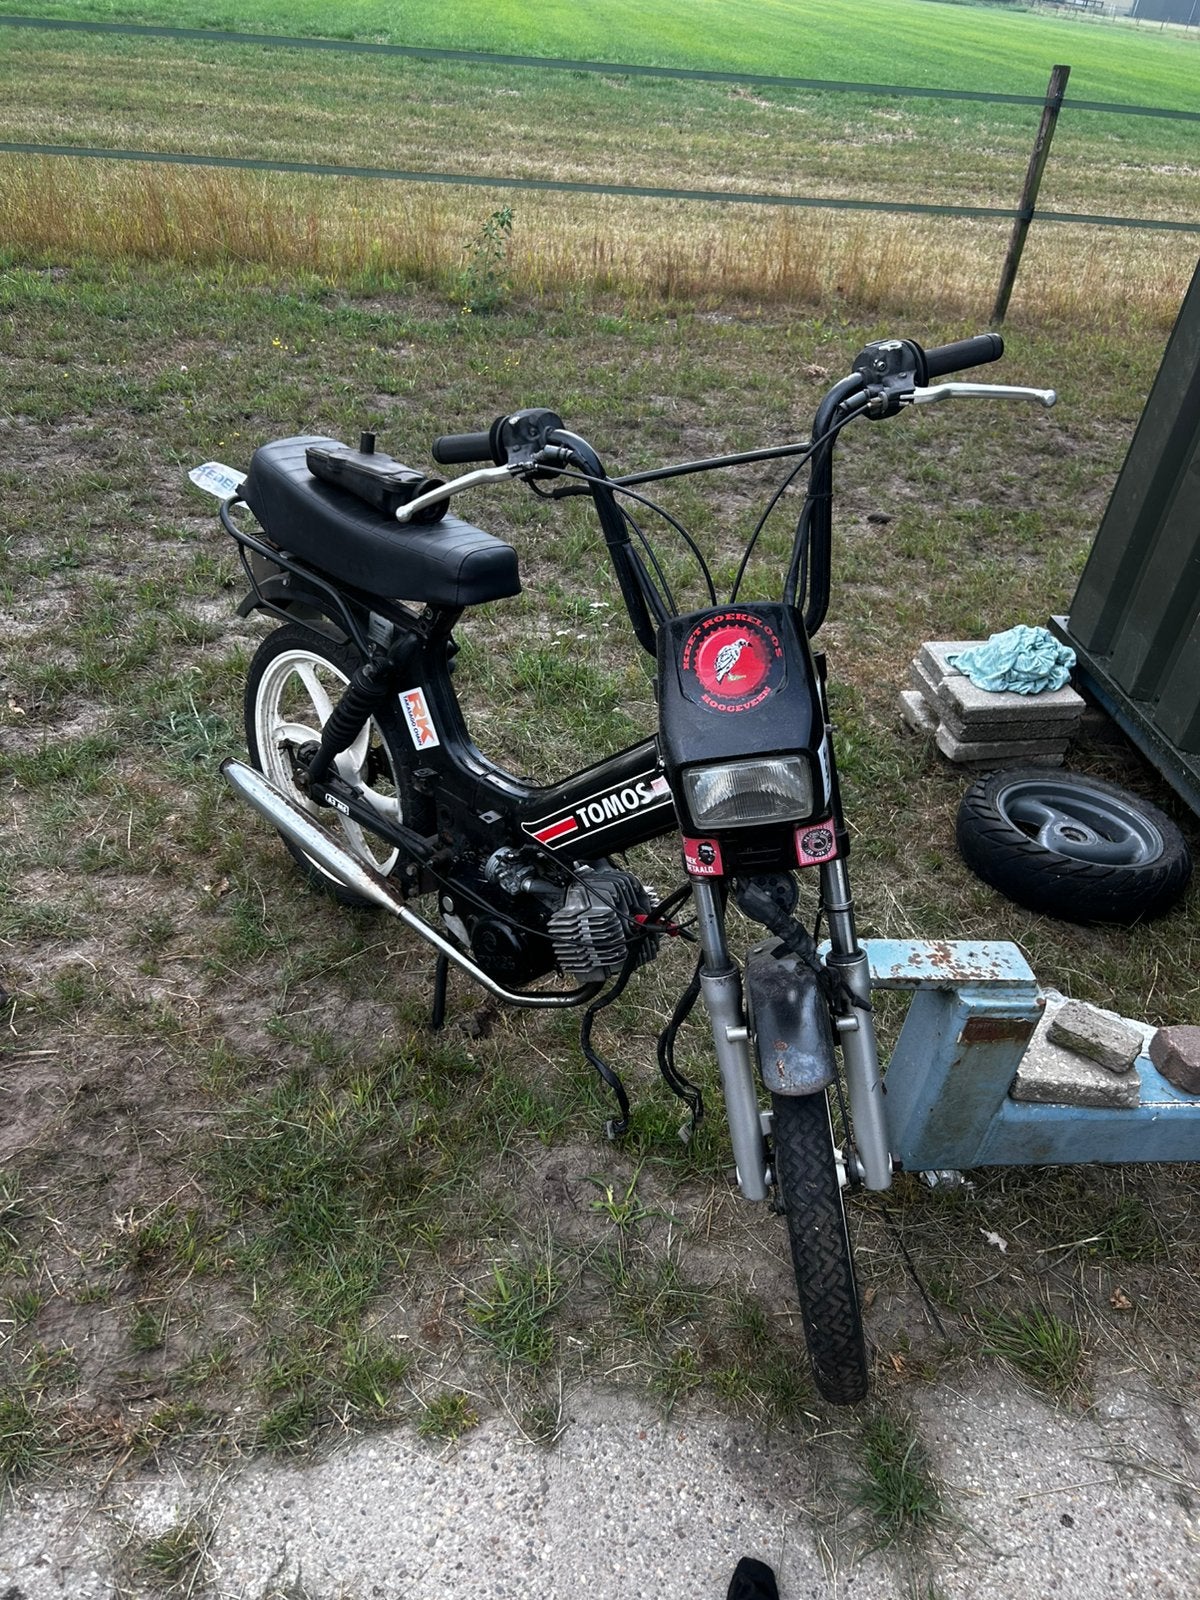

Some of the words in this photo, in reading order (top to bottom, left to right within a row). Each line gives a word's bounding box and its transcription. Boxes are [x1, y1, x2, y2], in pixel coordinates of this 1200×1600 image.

[701, 613, 783, 658] ROEKELOOS
[407, 692, 436, 744] RK
[701, 685, 772, 713] HOOGEVEEN
[413, 727, 423, 746] CHAIN
[575, 781, 656, 828] TOMOS
